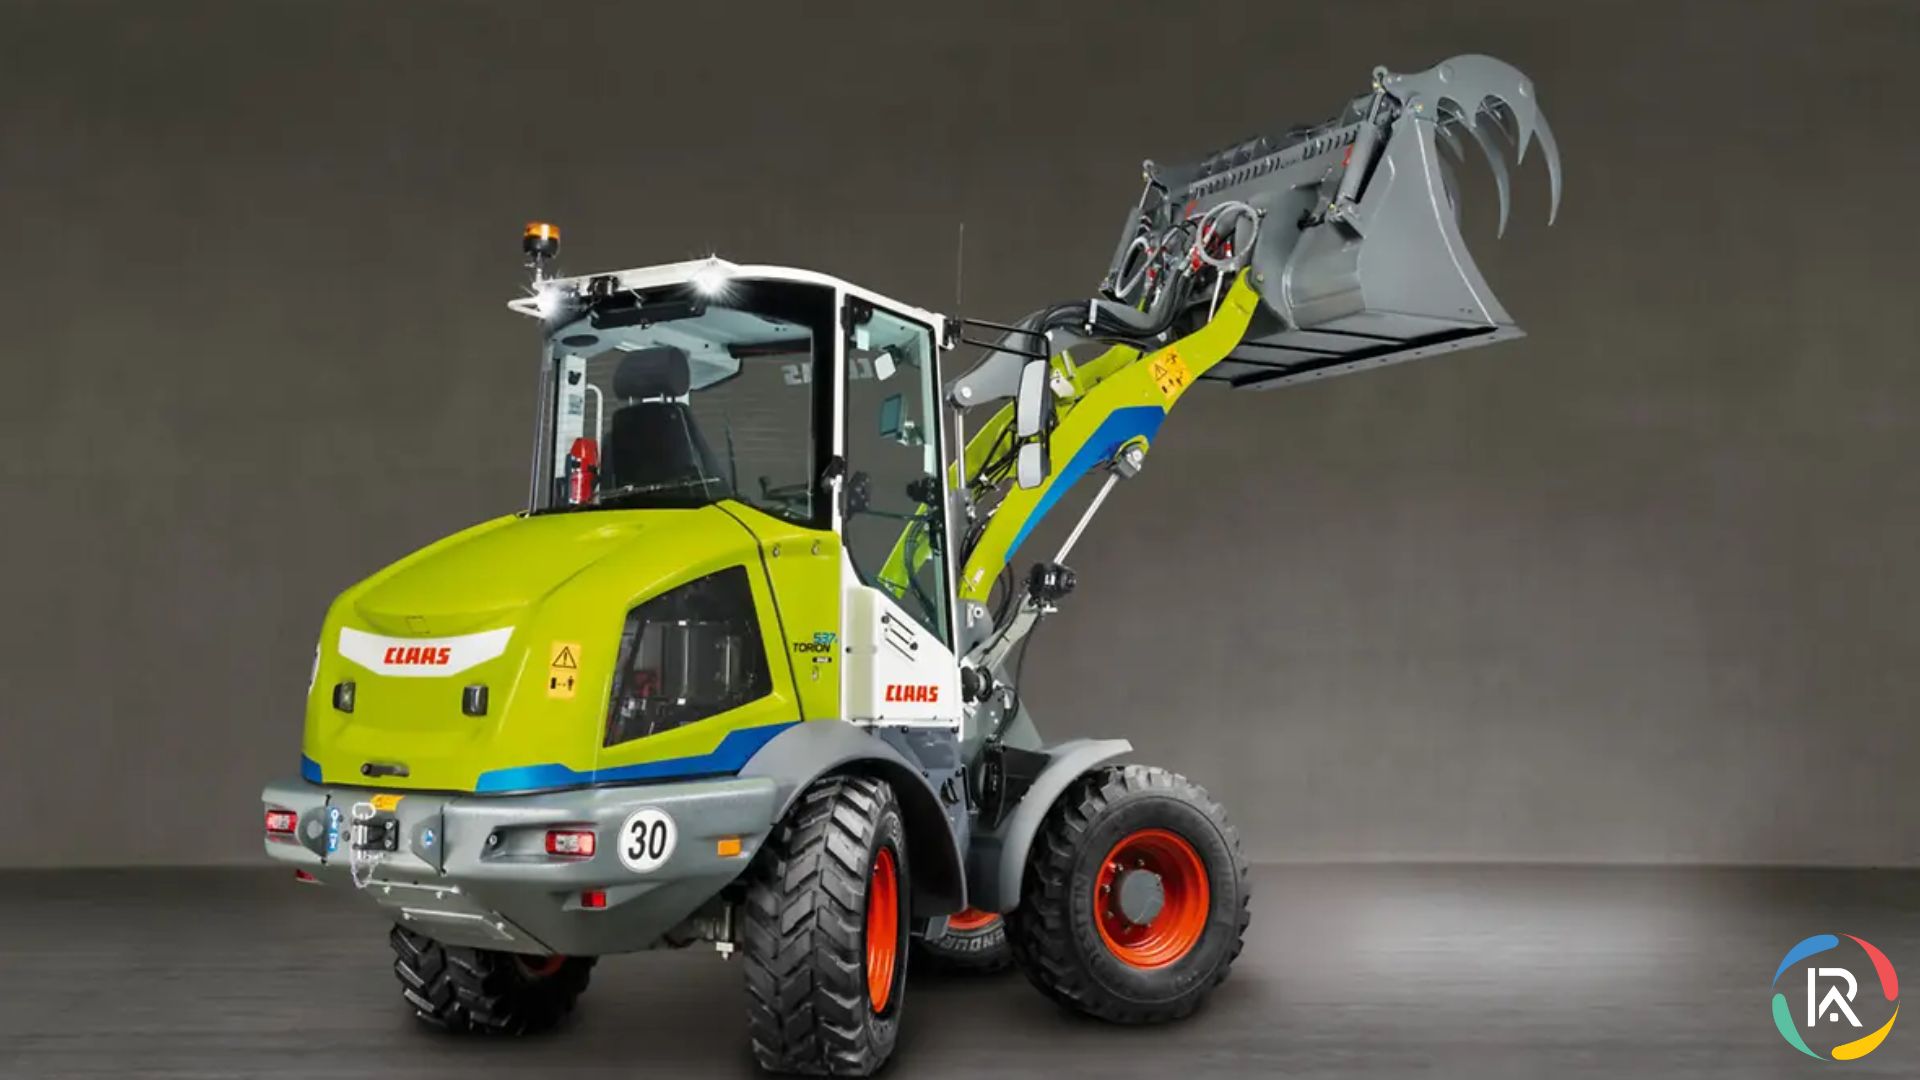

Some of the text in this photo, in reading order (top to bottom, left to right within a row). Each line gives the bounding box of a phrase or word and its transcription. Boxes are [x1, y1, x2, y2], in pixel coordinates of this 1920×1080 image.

[384, 647, 451, 664] CLAAS
[793, 642, 831, 653] TORION
[885, 685, 938, 702] CLAAS
[628, 820, 667, 860] 30
